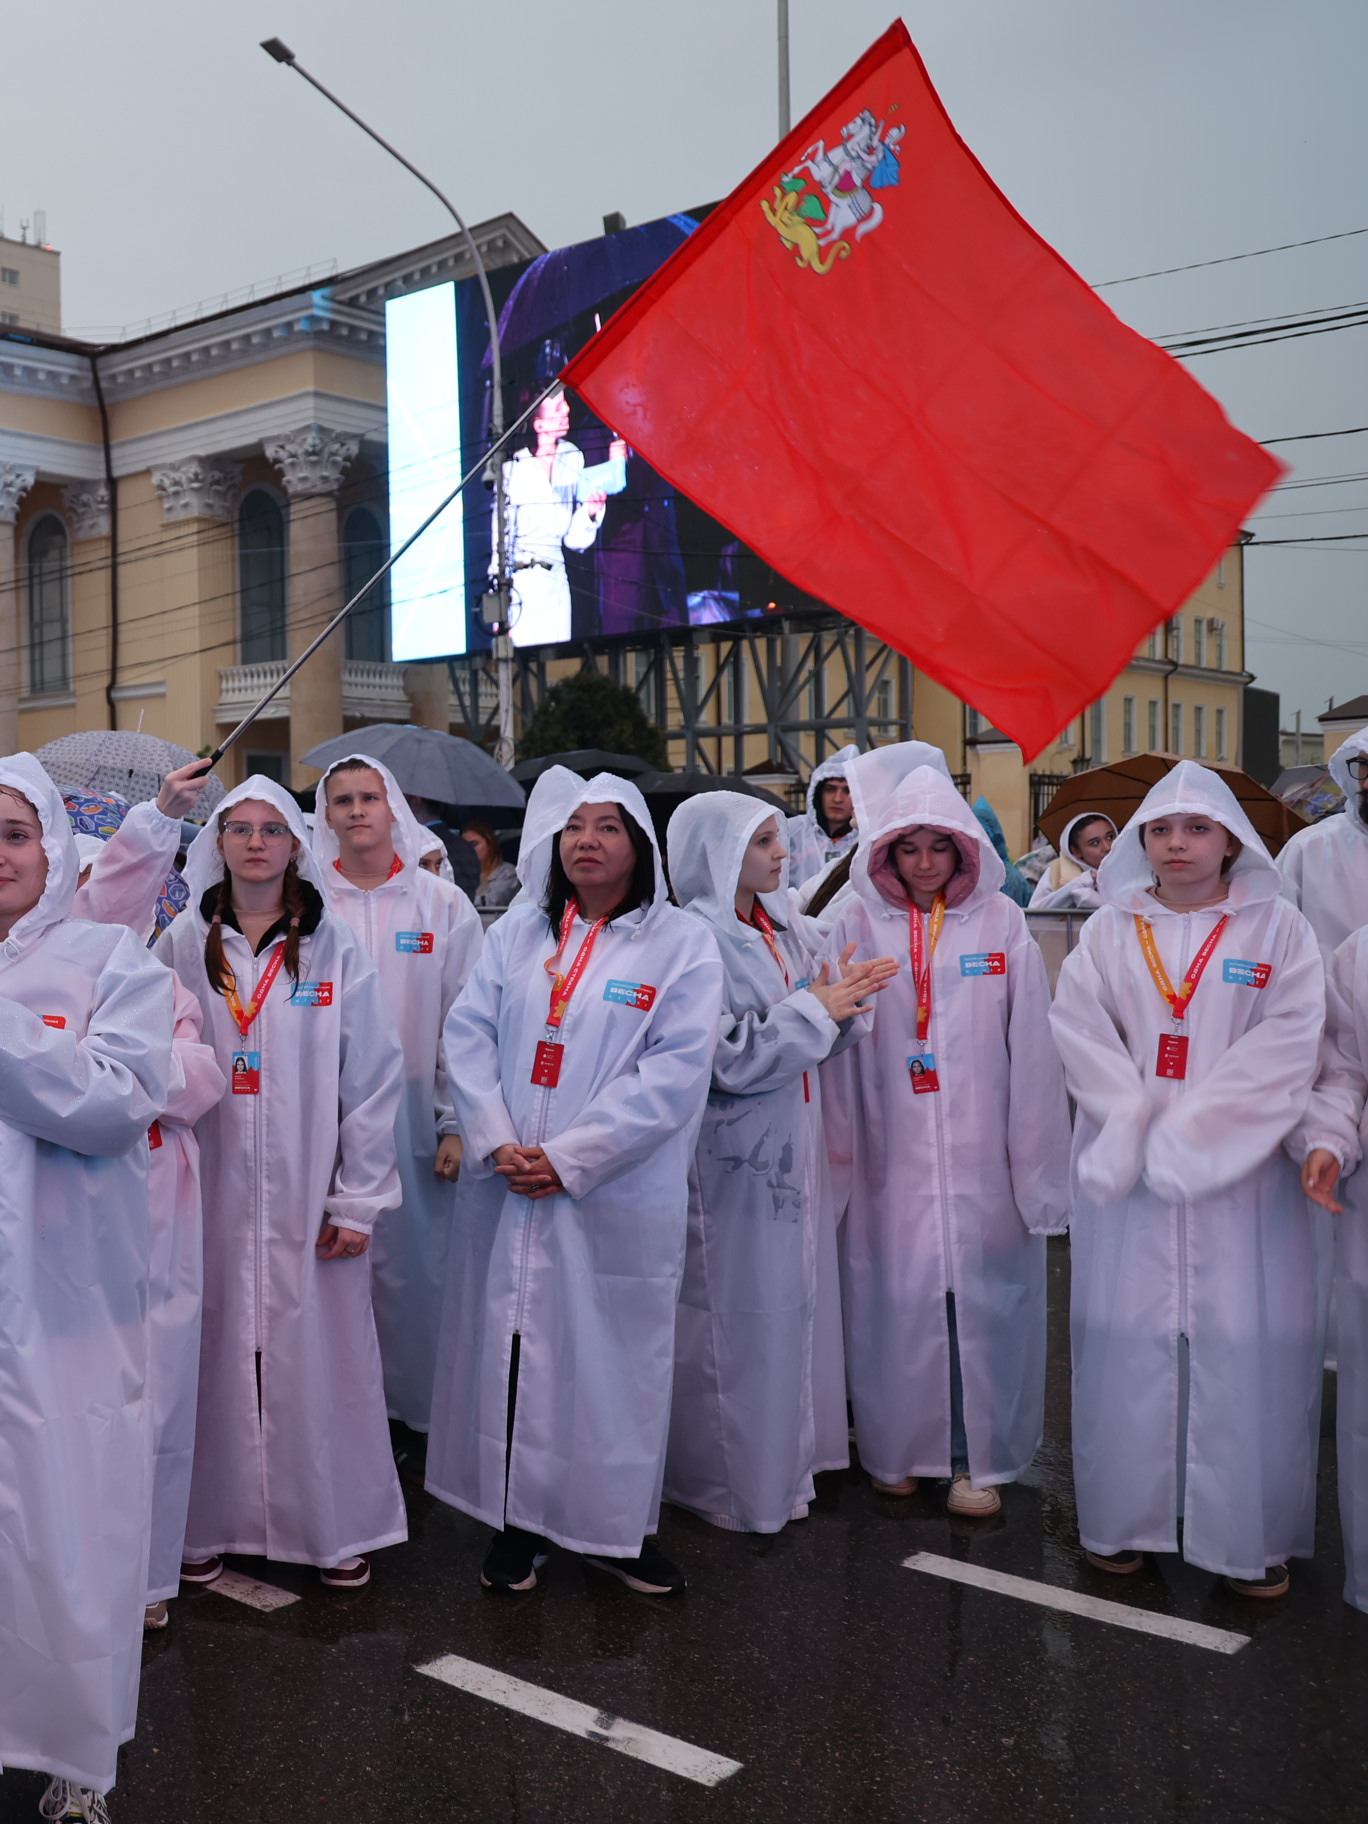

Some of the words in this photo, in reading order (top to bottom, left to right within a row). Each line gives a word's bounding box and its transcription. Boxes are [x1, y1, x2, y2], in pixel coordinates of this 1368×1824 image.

[576, 946, 588, 967] ОДНА
[964, 960, 1001, 969] ВЕСНА
[1190, 957, 1204, 980] ОДНА
[1201, 934, 1217, 957] ВЕСНА
[256, 978, 270, 1000] ОДНА
[267, 955, 281, 977] ВЕСНА
[563, 968, 579, 997] СТРАНА
[1228, 967, 1267, 980] ВЕСНА
[610, 987, 649, 1002] ВЕСНА
